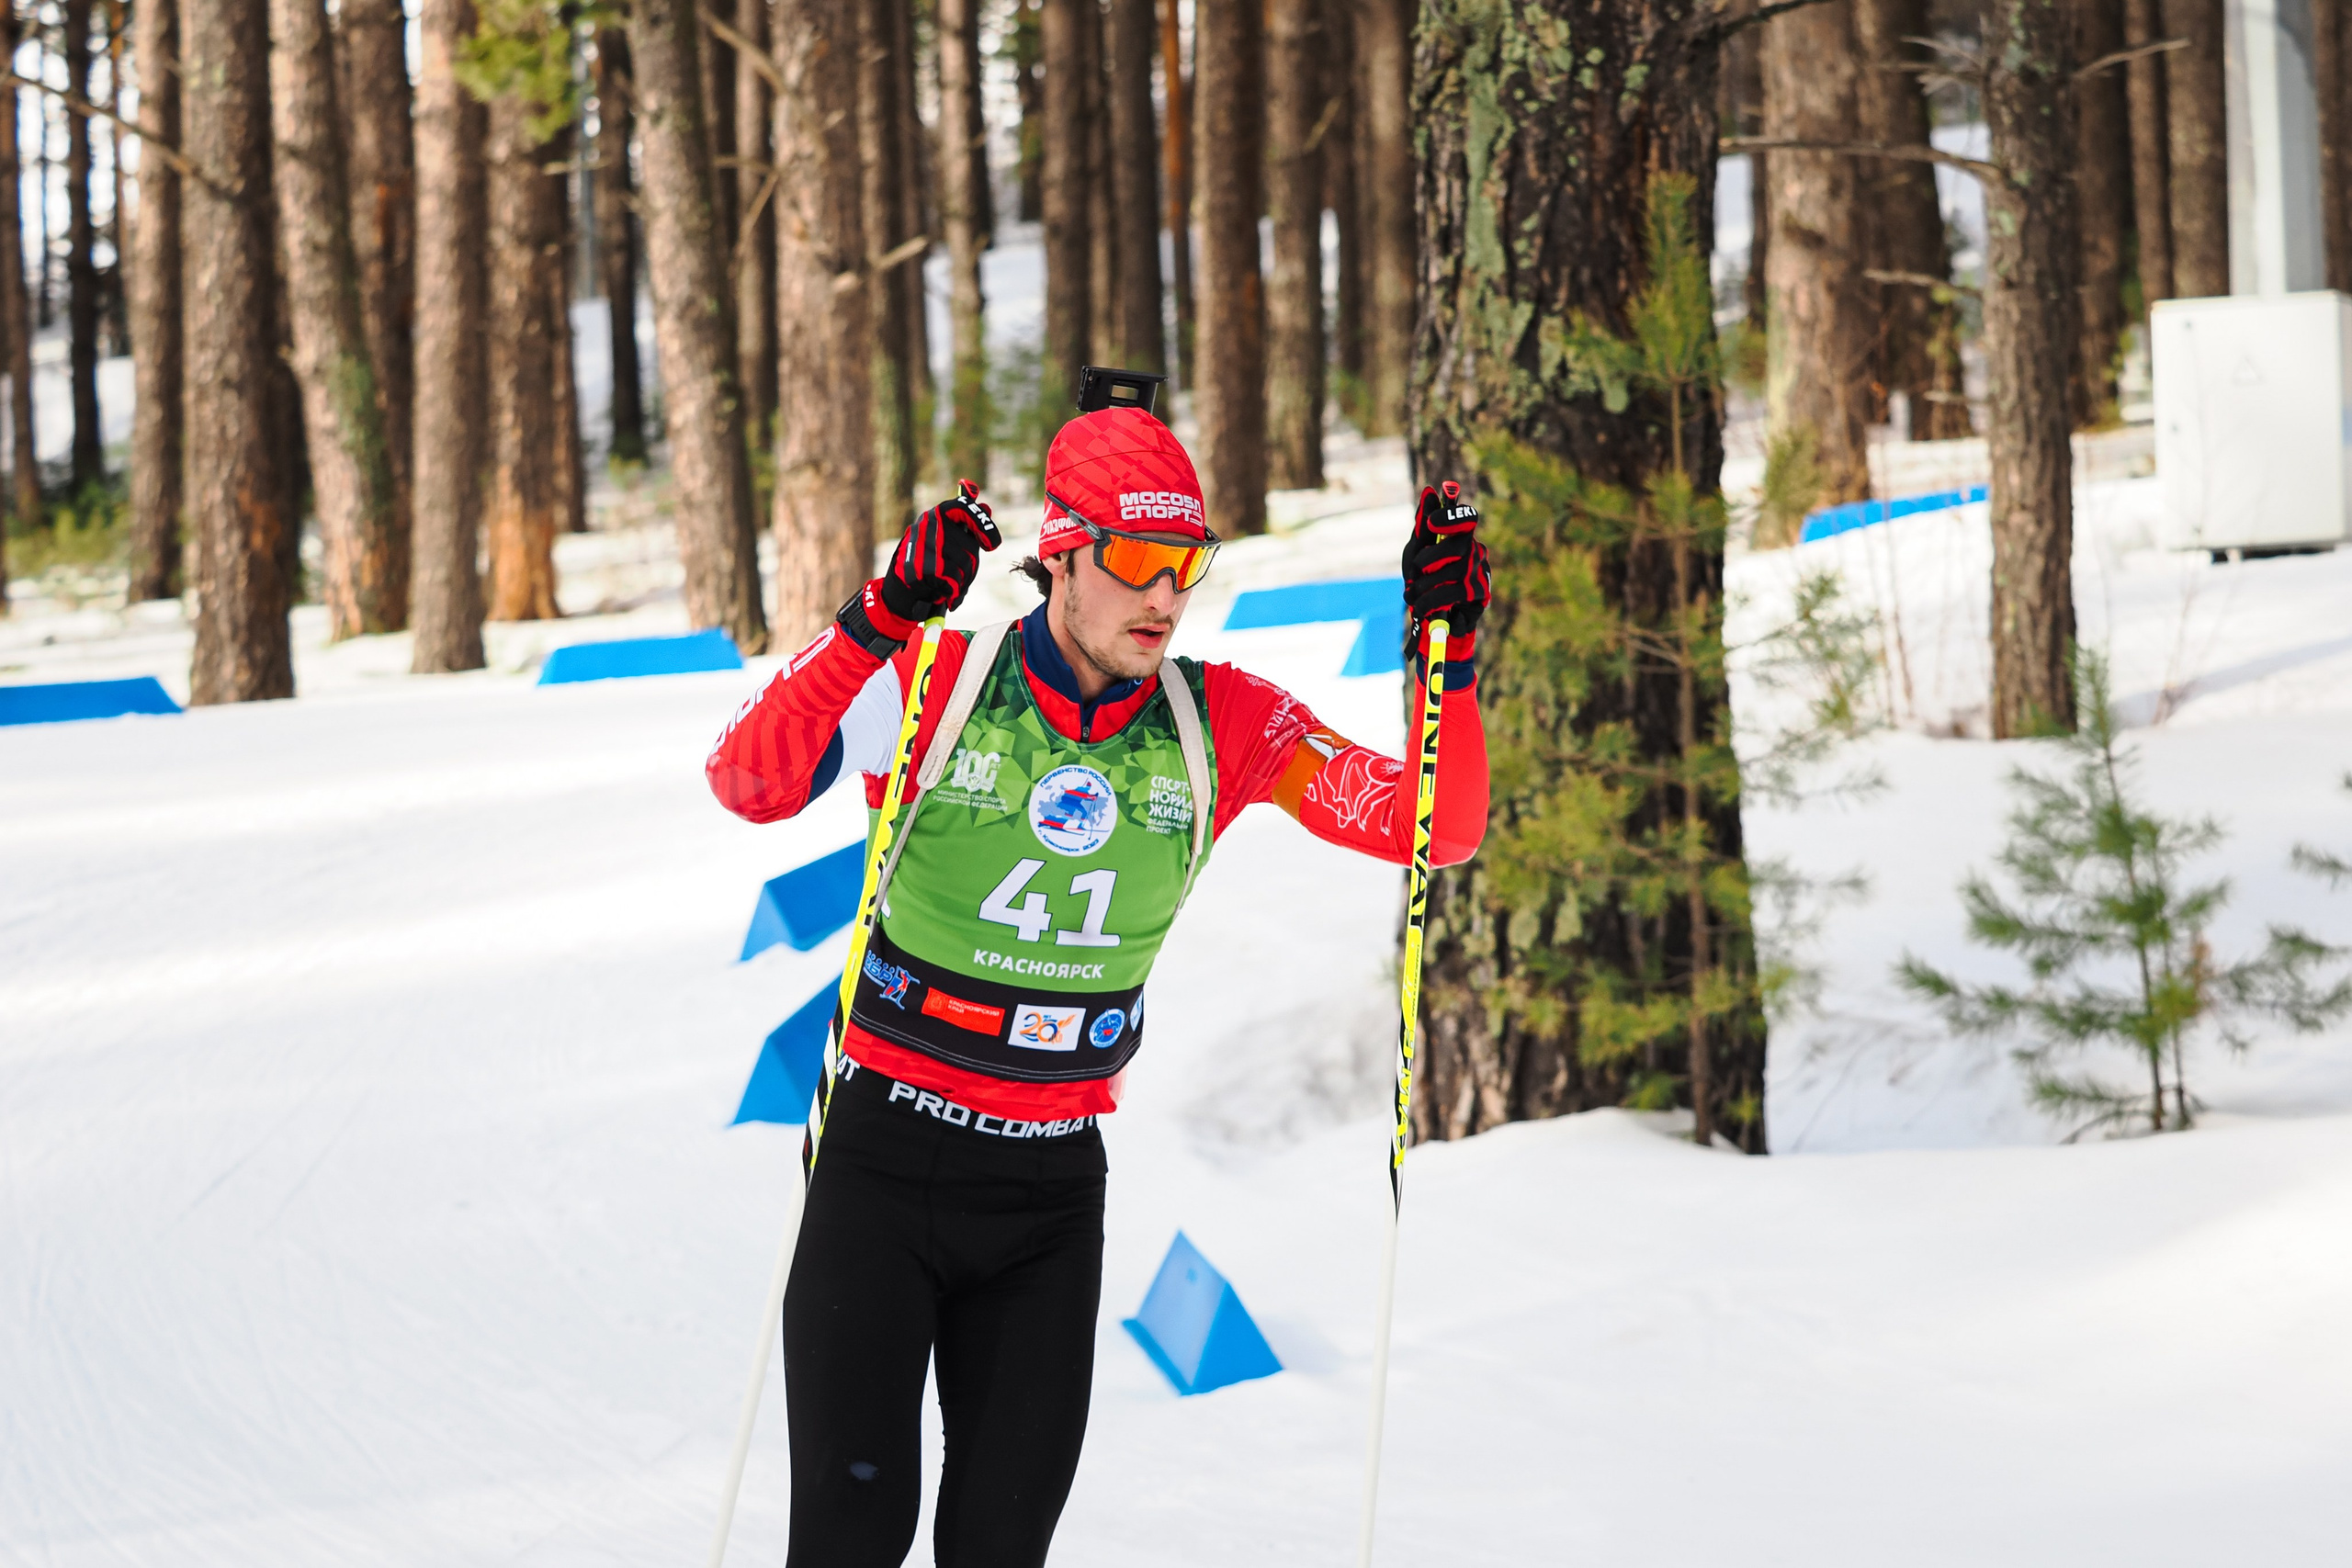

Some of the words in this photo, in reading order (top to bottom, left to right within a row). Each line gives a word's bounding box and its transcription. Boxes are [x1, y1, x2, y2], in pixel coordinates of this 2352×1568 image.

[957, 496, 994, 531] LEKI
[1121, 504, 1193, 522] СПОРТ
[1447, 506, 1477, 521] LEKI
[1419, 660, 1444, 798] ONE
[1039, 767, 1088, 788] ПЕРВЕНСТВО
[1088, 770, 1112, 796] РОССИИ
[933, 795, 971, 807] РОССИЙСКОЙ
[971, 801, 1009, 811] ФЕДЕРАЦИИ
[937, 789, 984, 802] МИНИСТЕРСТВО
[984, 795, 1007, 805] СПОРТА
[978, 856, 1122, 947] 41
[974, 948, 1106, 979] КРАСНОЯРСК
[947, 1004, 965, 1014] КРАЙ
[948, 999, 1001, 1017] КРАСНОЯРСКИЙ
[888, 1080, 971, 1126] PRO
